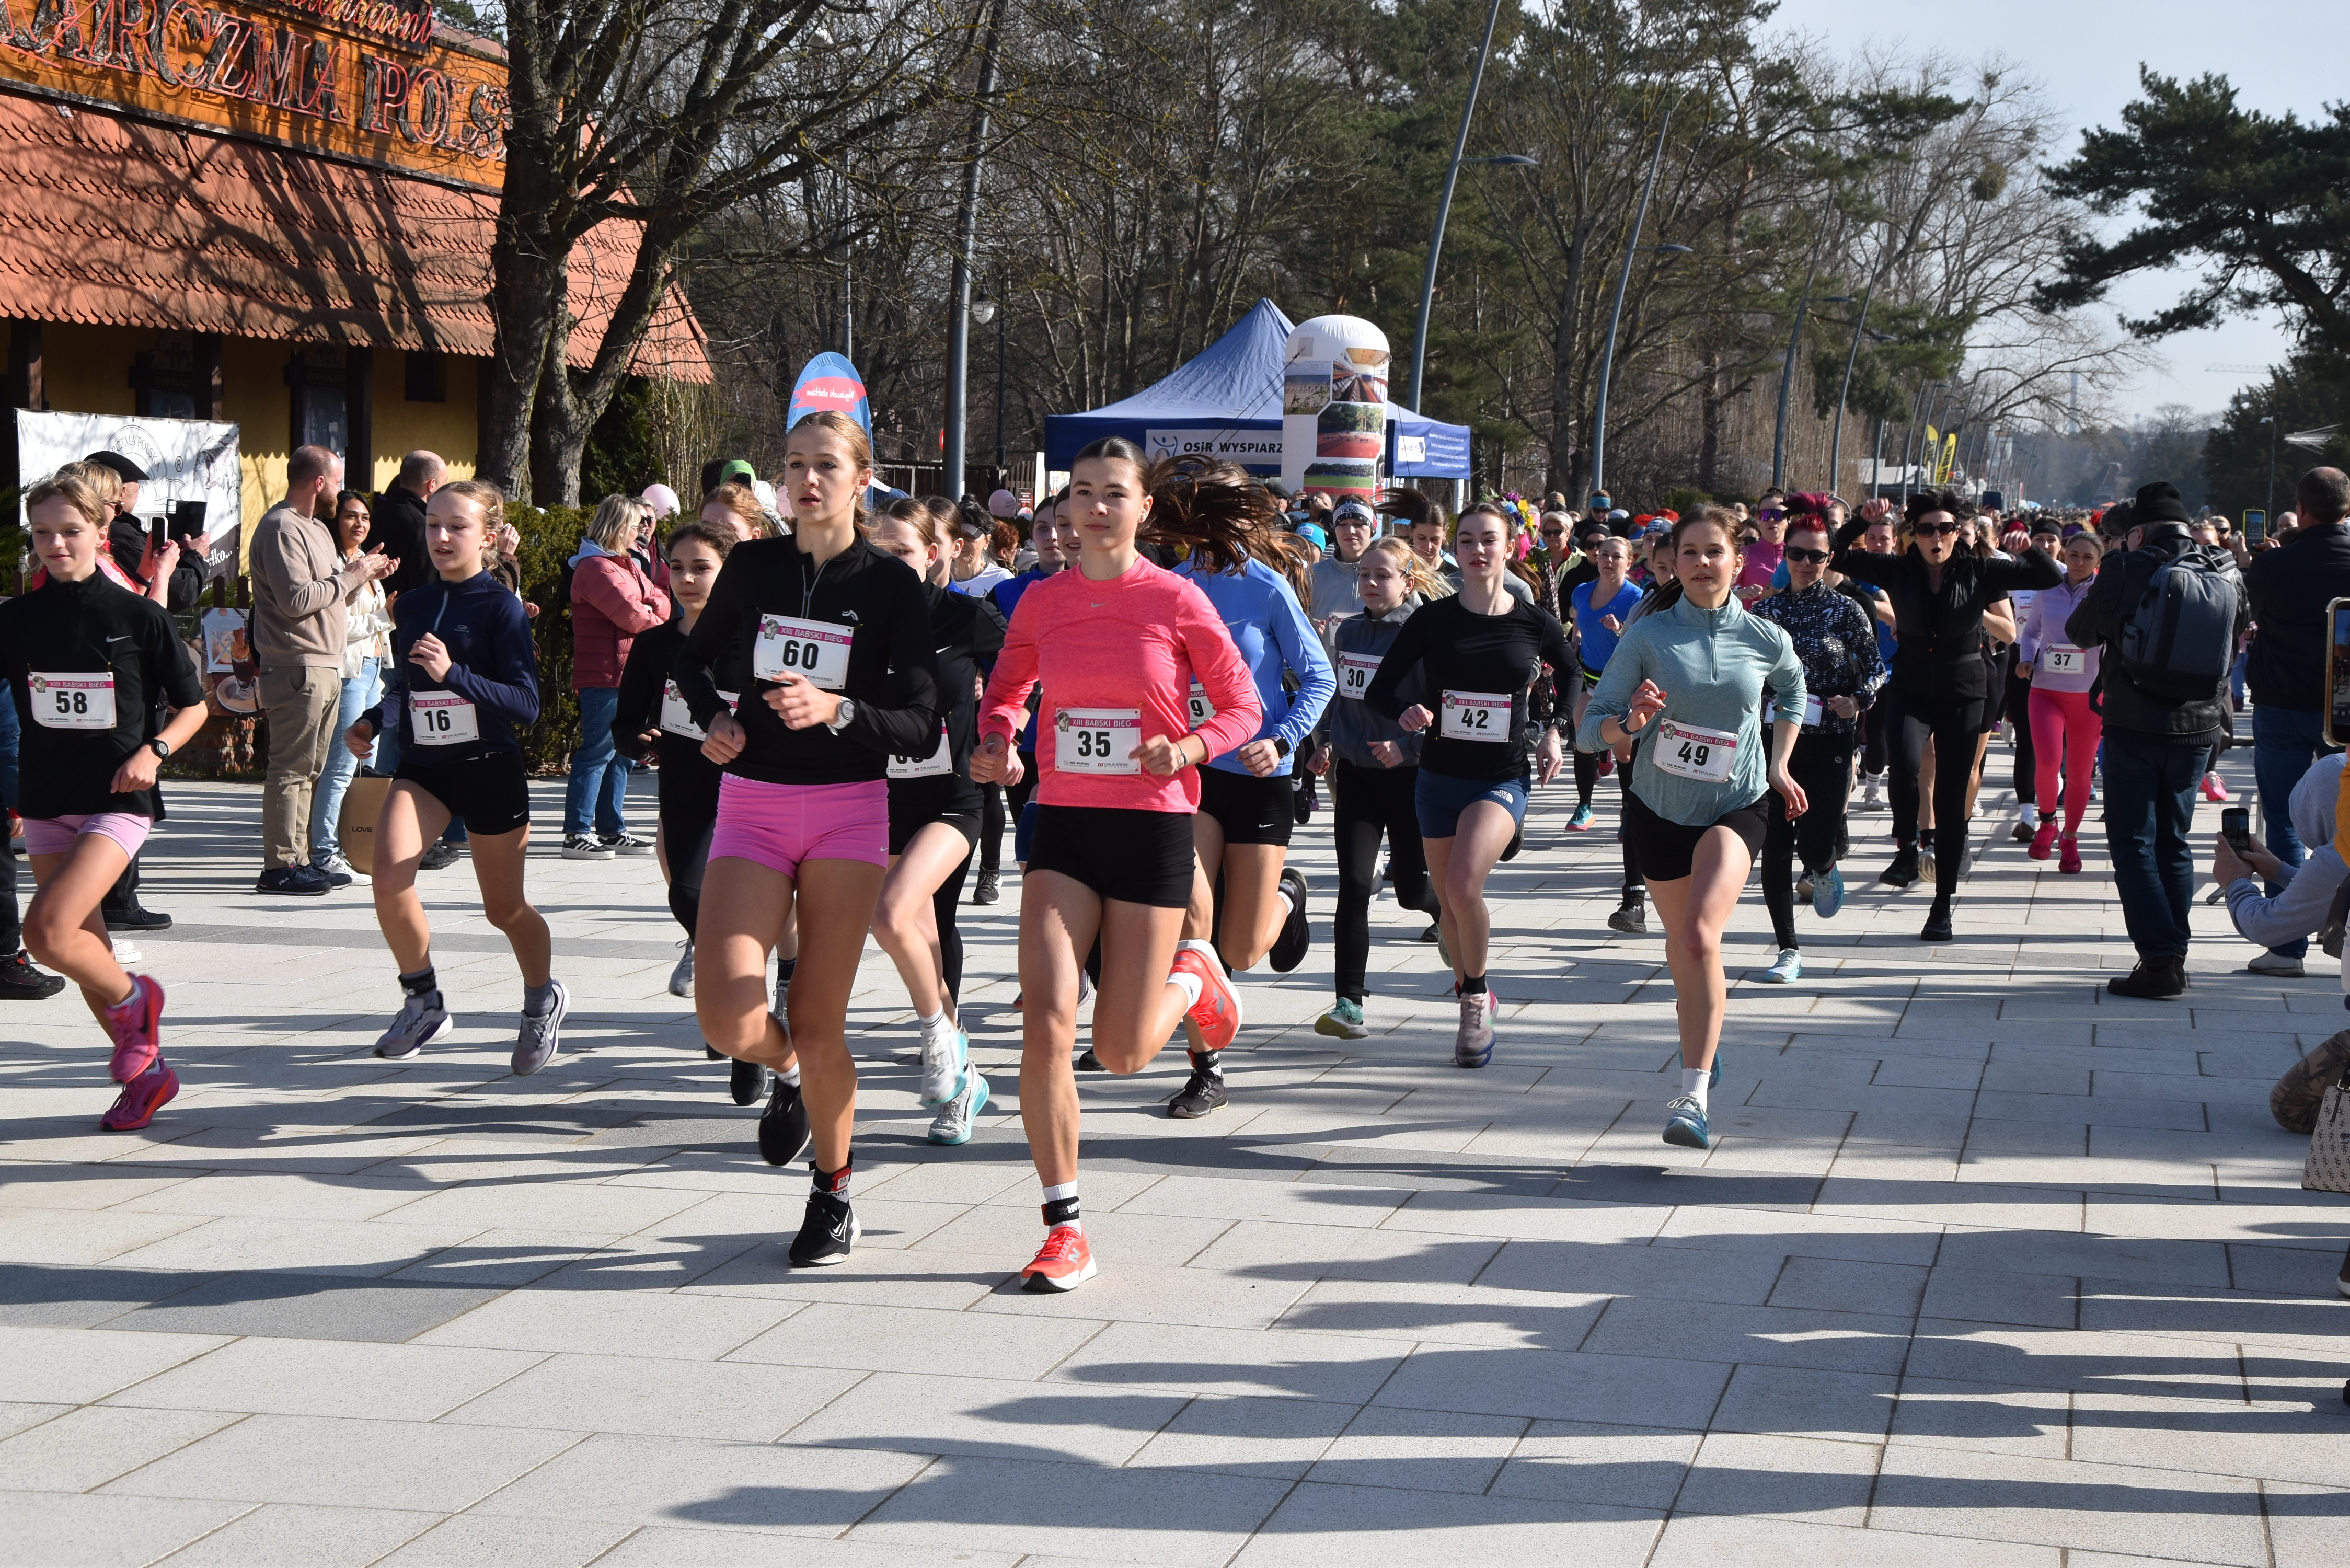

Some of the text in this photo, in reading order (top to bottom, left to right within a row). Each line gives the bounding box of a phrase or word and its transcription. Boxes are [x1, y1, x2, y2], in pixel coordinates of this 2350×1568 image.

[137, 436, 160, 472] POLSKA
[1183, 441, 1213, 452] OSiR
[795, 629, 822, 640] BABSKI
[824, 634, 843, 643] BIEG
[782, 640, 819, 670] 60
[2054, 654, 2071, 666] 37
[1347, 668, 1365, 688] 30
[56, 691, 87, 714] 58
[1190, 699, 1204, 717] 9
[424, 709, 451, 732] 16
[1461, 709, 1489, 729] 42
[1078, 730, 1110, 757] 35
[1690, 734, 1713, 743] BABSKI
[1677, 741, 1709, 766] 49
